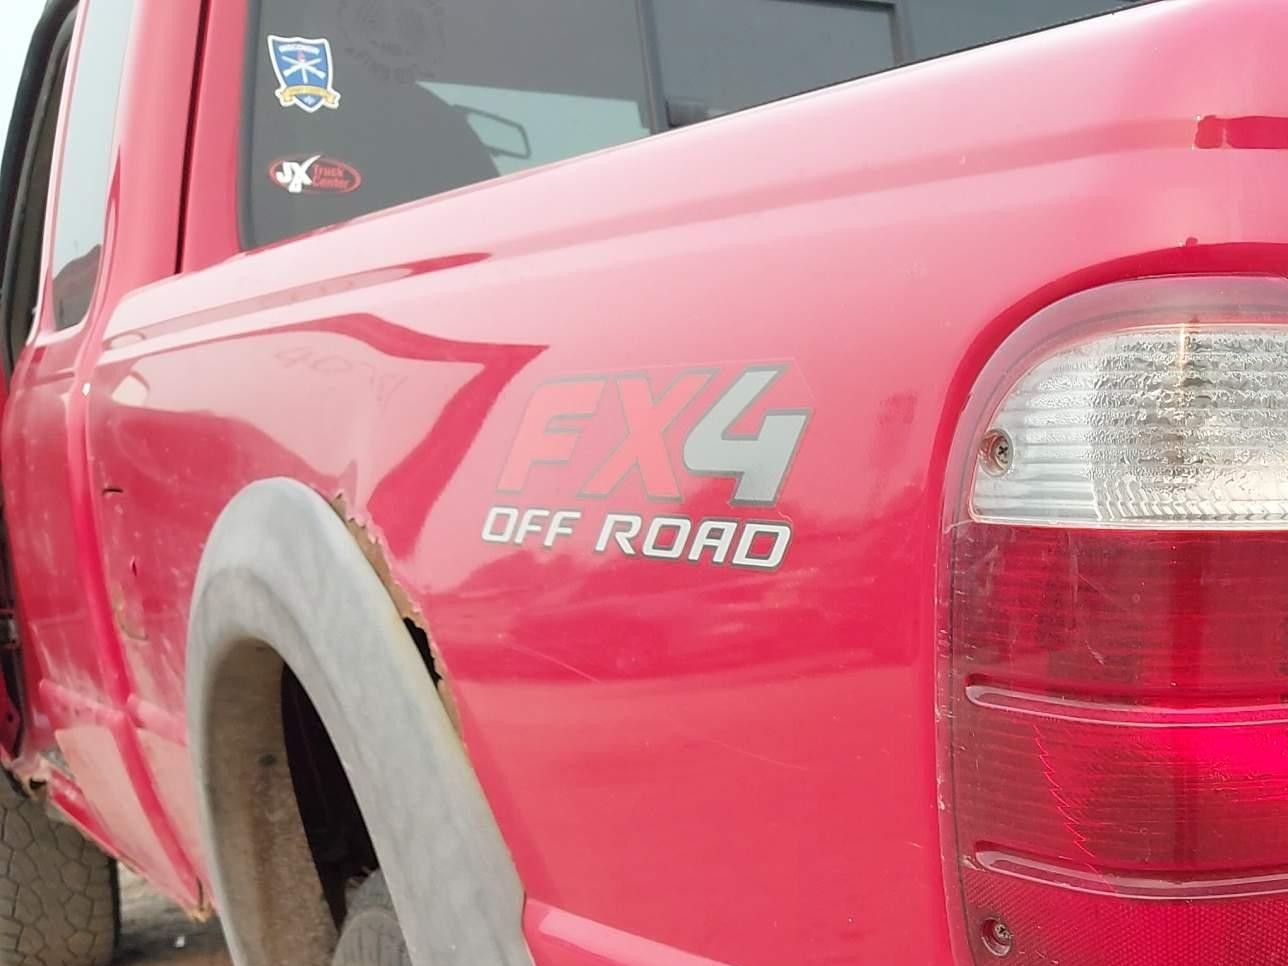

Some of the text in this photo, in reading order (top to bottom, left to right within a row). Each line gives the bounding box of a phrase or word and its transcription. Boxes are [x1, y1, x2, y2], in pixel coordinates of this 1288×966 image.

[497, 362, 812, 506] FX4
[481, 505, 793, 572] OFF ROAD
